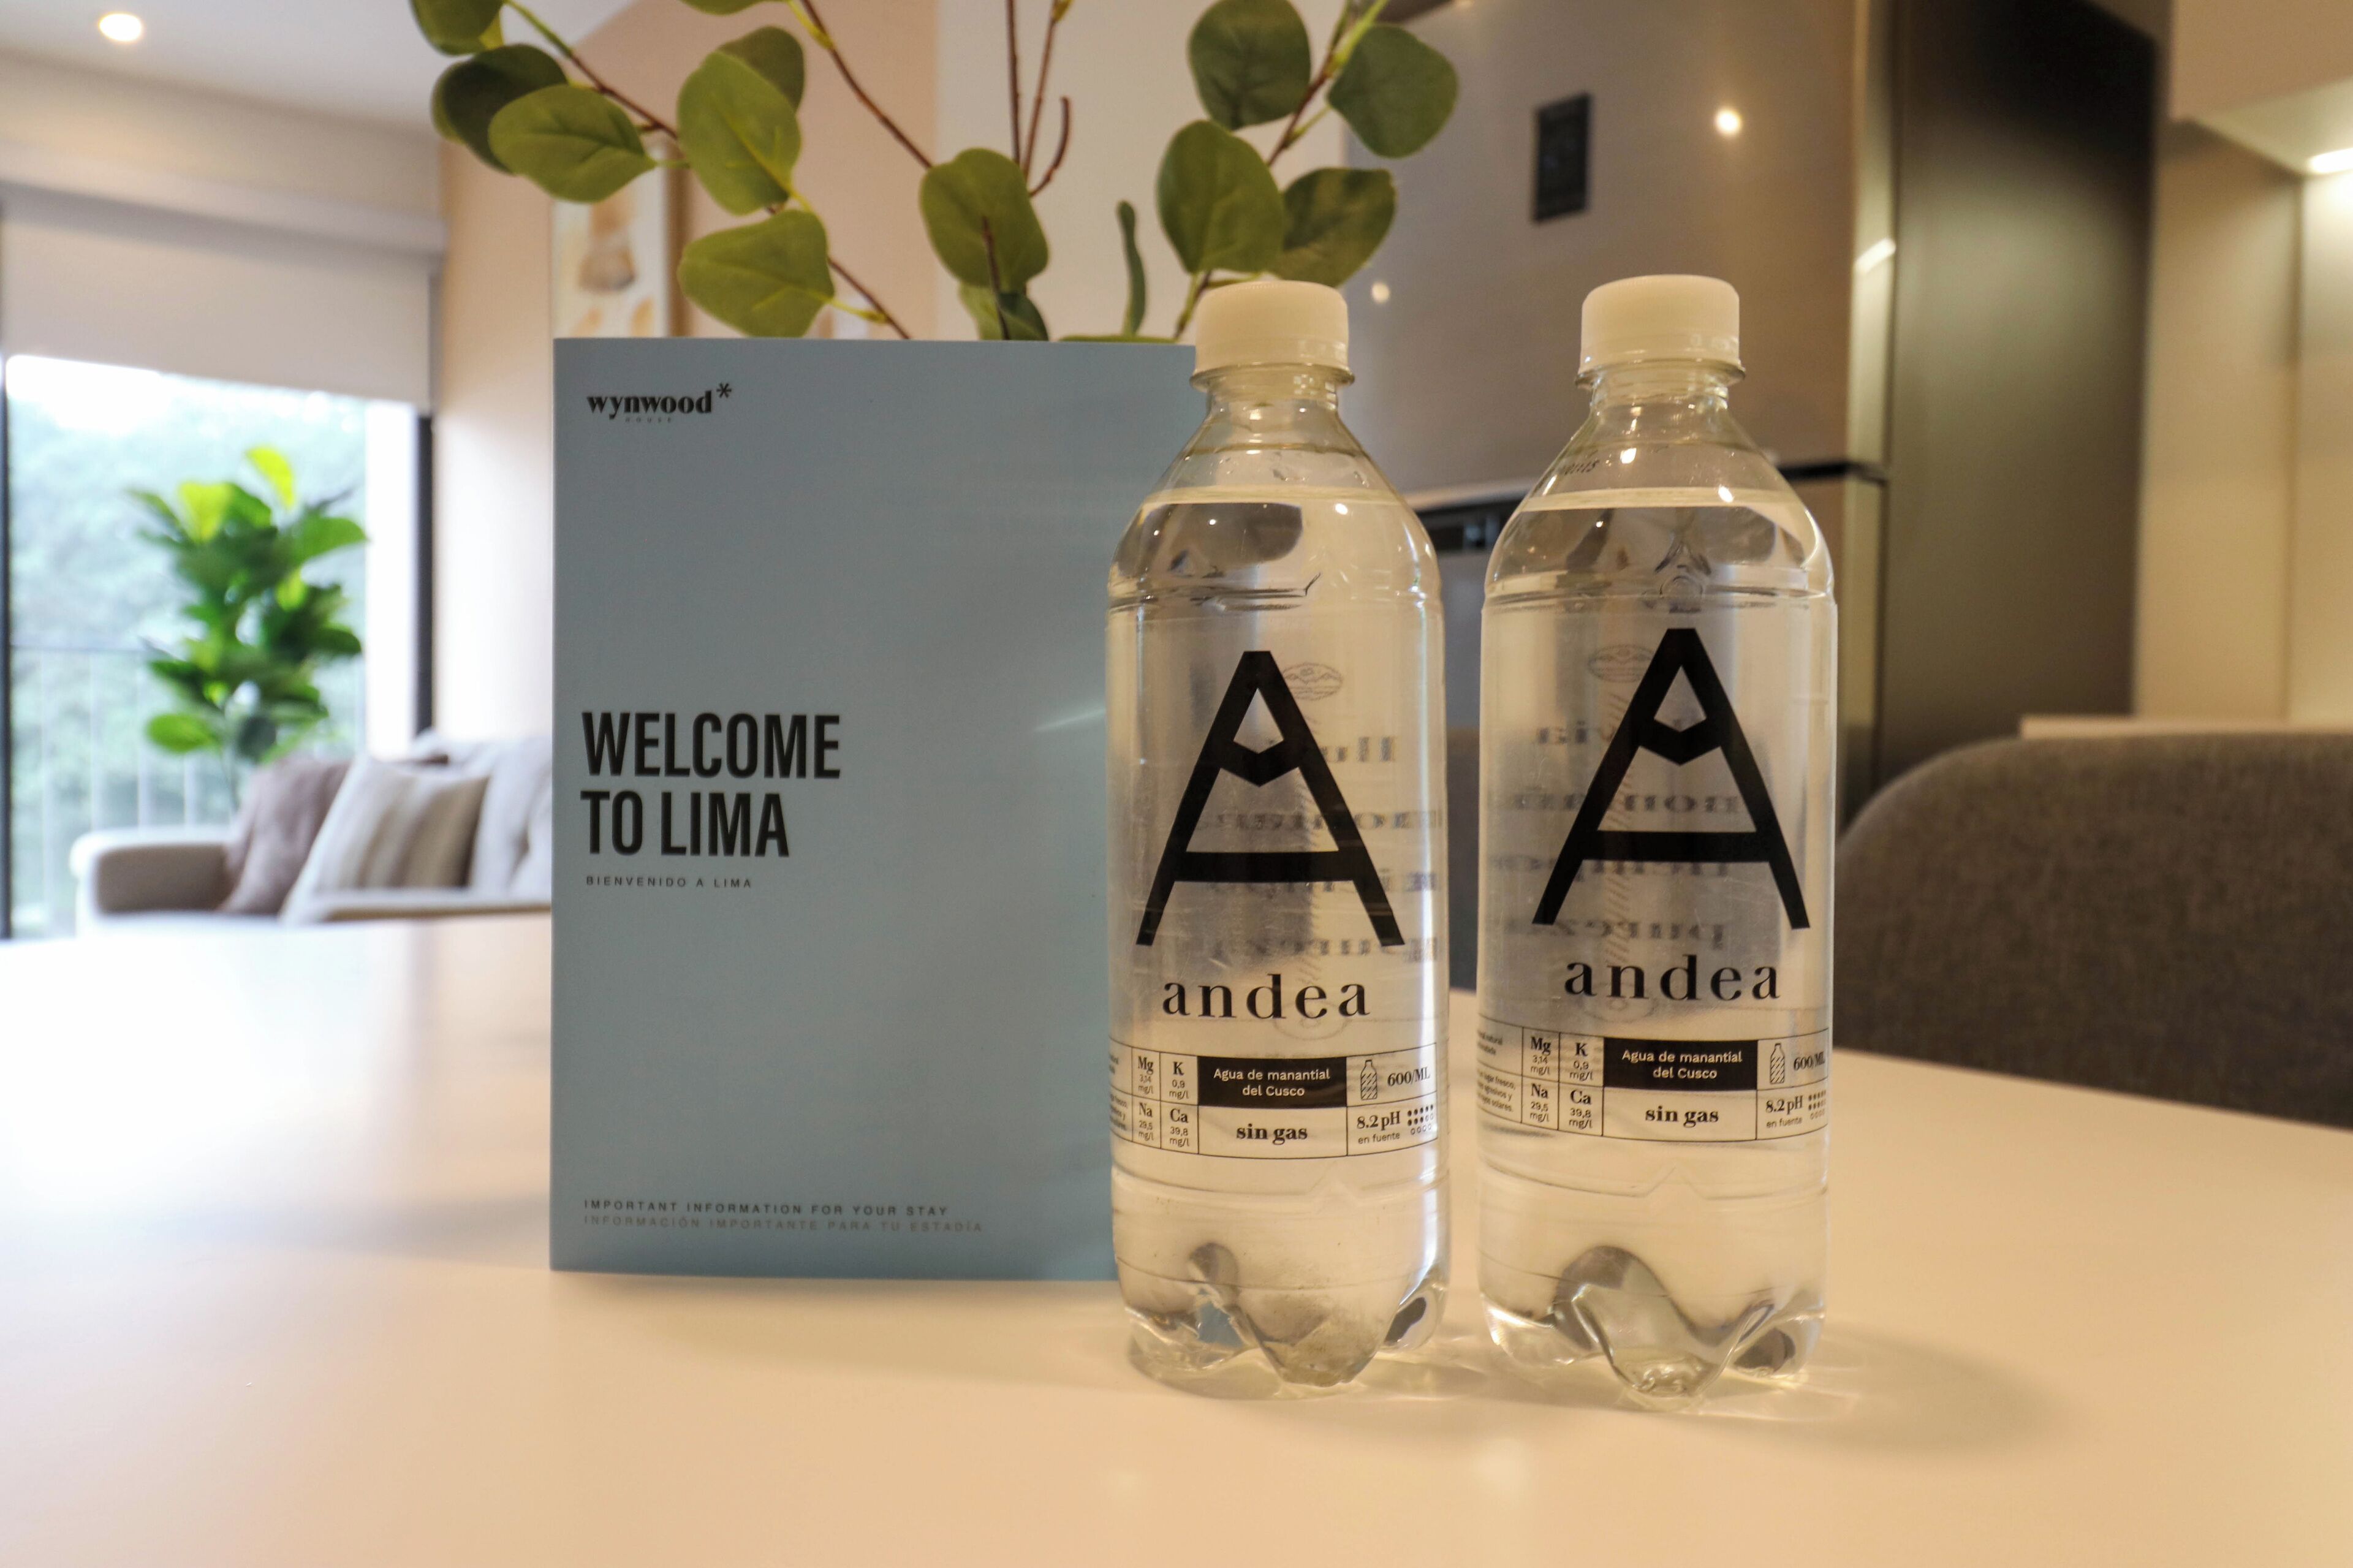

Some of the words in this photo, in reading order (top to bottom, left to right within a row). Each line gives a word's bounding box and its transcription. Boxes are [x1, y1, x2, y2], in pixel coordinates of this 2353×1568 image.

[582, 711, 841, 779] WELCOME
[580, 790, 643, 855] TO
[661, 792, 789, 857] LIMA
[586, 876, 687, 887] BIENVENIDO
[696, 878, 704, 887] A
[714, 878, 751, 888] LIMA
[1564, 955, 1781, 1001] andea
[1163, 974, 1370, 1019] andea
[1531, 1037, 1551, 1056] Mg
[1575, 1043, 1588, 1056] K
[1622, 1050, 1654, 1063] Agua
[1659, 1051, 1675, 1061] de
[1680, 1051, 1743, 1062] manantial
[1138, 1056, 1153, 1075] Mg
[1173, 1061, 1184, 1075] K
[1531, 1066, 1550, 1075] mg/l
[1653, 1067, 1673, 1078] del
[1678, 1068, 1718, 1078] Cusco
[1213, 1069, 1243, 1081] Agua
[1248, 1069, 1263, 1080] de
[1268, 1069, 1330, 1080] manantial
[1387, 1067, 1430, 1086] 600/ML
[1570, 1072, 1593, 1081] mg/l
[1169, 1091, 1189, 1100] mg/l
[1243, 1085, 1262, 1096] del
[1266, 1086, 1305, 1096] Cusco
[1531, 1083, 1548, 1098] Na
[1571, 1089, 1591, 1104] Ca
[1139, 1102, 1153, 1118] Na
[1170, 1108, 1188, 1123] Ca
[1570, 1108, 1591, 1118] 39,8
[1645, 1105, 1678, 1122] sin
[1683, 1111, 1719, 1128] gas
[1569, 1119, 1593, 1129] mg/l
[1779, 1117, 1803, 1126] fuente
[1170, 1126, 1189, 1136] 39,8
[1237, 1123, 1267, 1139] sin
[1272, 1127, 1308, 1145] gas
[1373, 1133, 1401, 1143] fuente
[1170, 1137, 1189, 1147] mg/l
[585, 1200, 676, 1211] IMPORTANT
[687, 1202, 801, 1214] INFORMATION
[811, 1205, 843, 1215] FOR
[853, 1205, 896, 1216] YOUR
[906, 1206, 948, 1216] STAY
[585, 1215, 700, 1229] INFORMACIÓN
[710, 1219, 817, 1231] IMPORTANTE
[828, 1222, 870, 1231] PARA
[881, 1222, 900, 1231] TU
